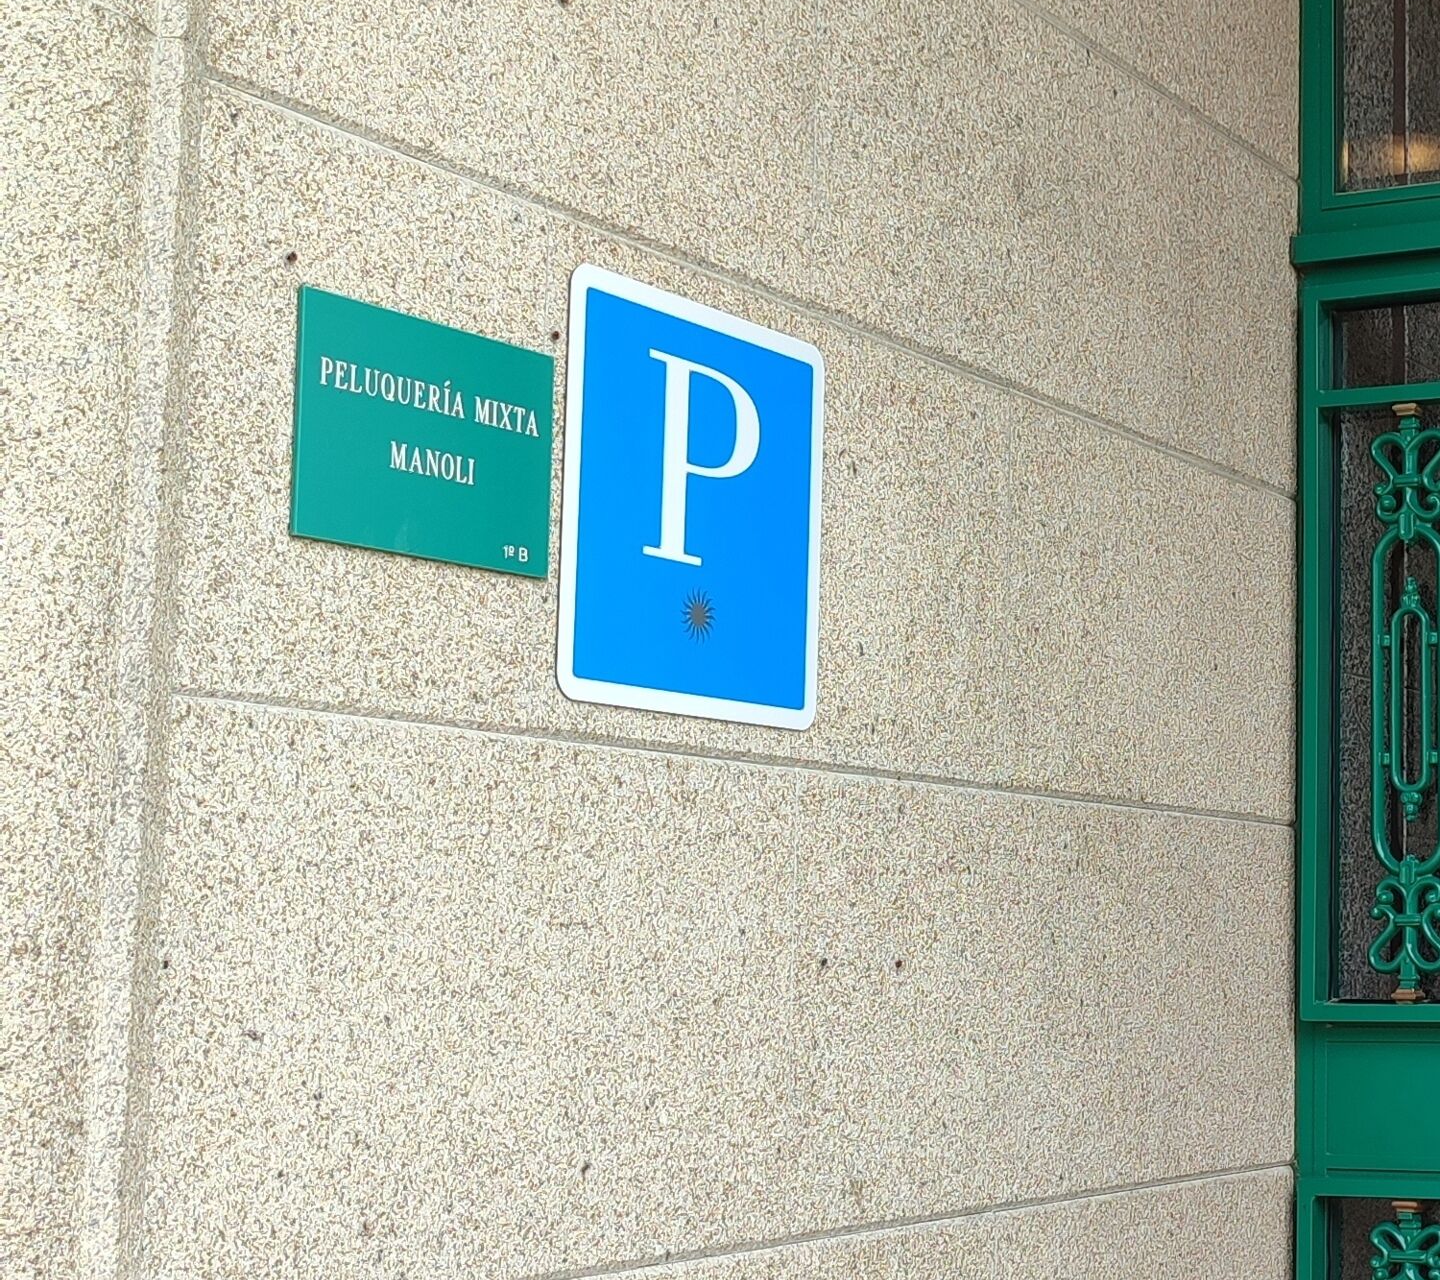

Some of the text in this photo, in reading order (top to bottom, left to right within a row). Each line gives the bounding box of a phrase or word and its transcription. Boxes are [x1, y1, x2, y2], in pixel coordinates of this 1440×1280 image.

[319, 356, 540, 438] PELUQUERÍA MIXTA
[389, 440, 475, 485] MANOLI
[643, 347, 761, 567] P
[518, 547, 528, 562] B
